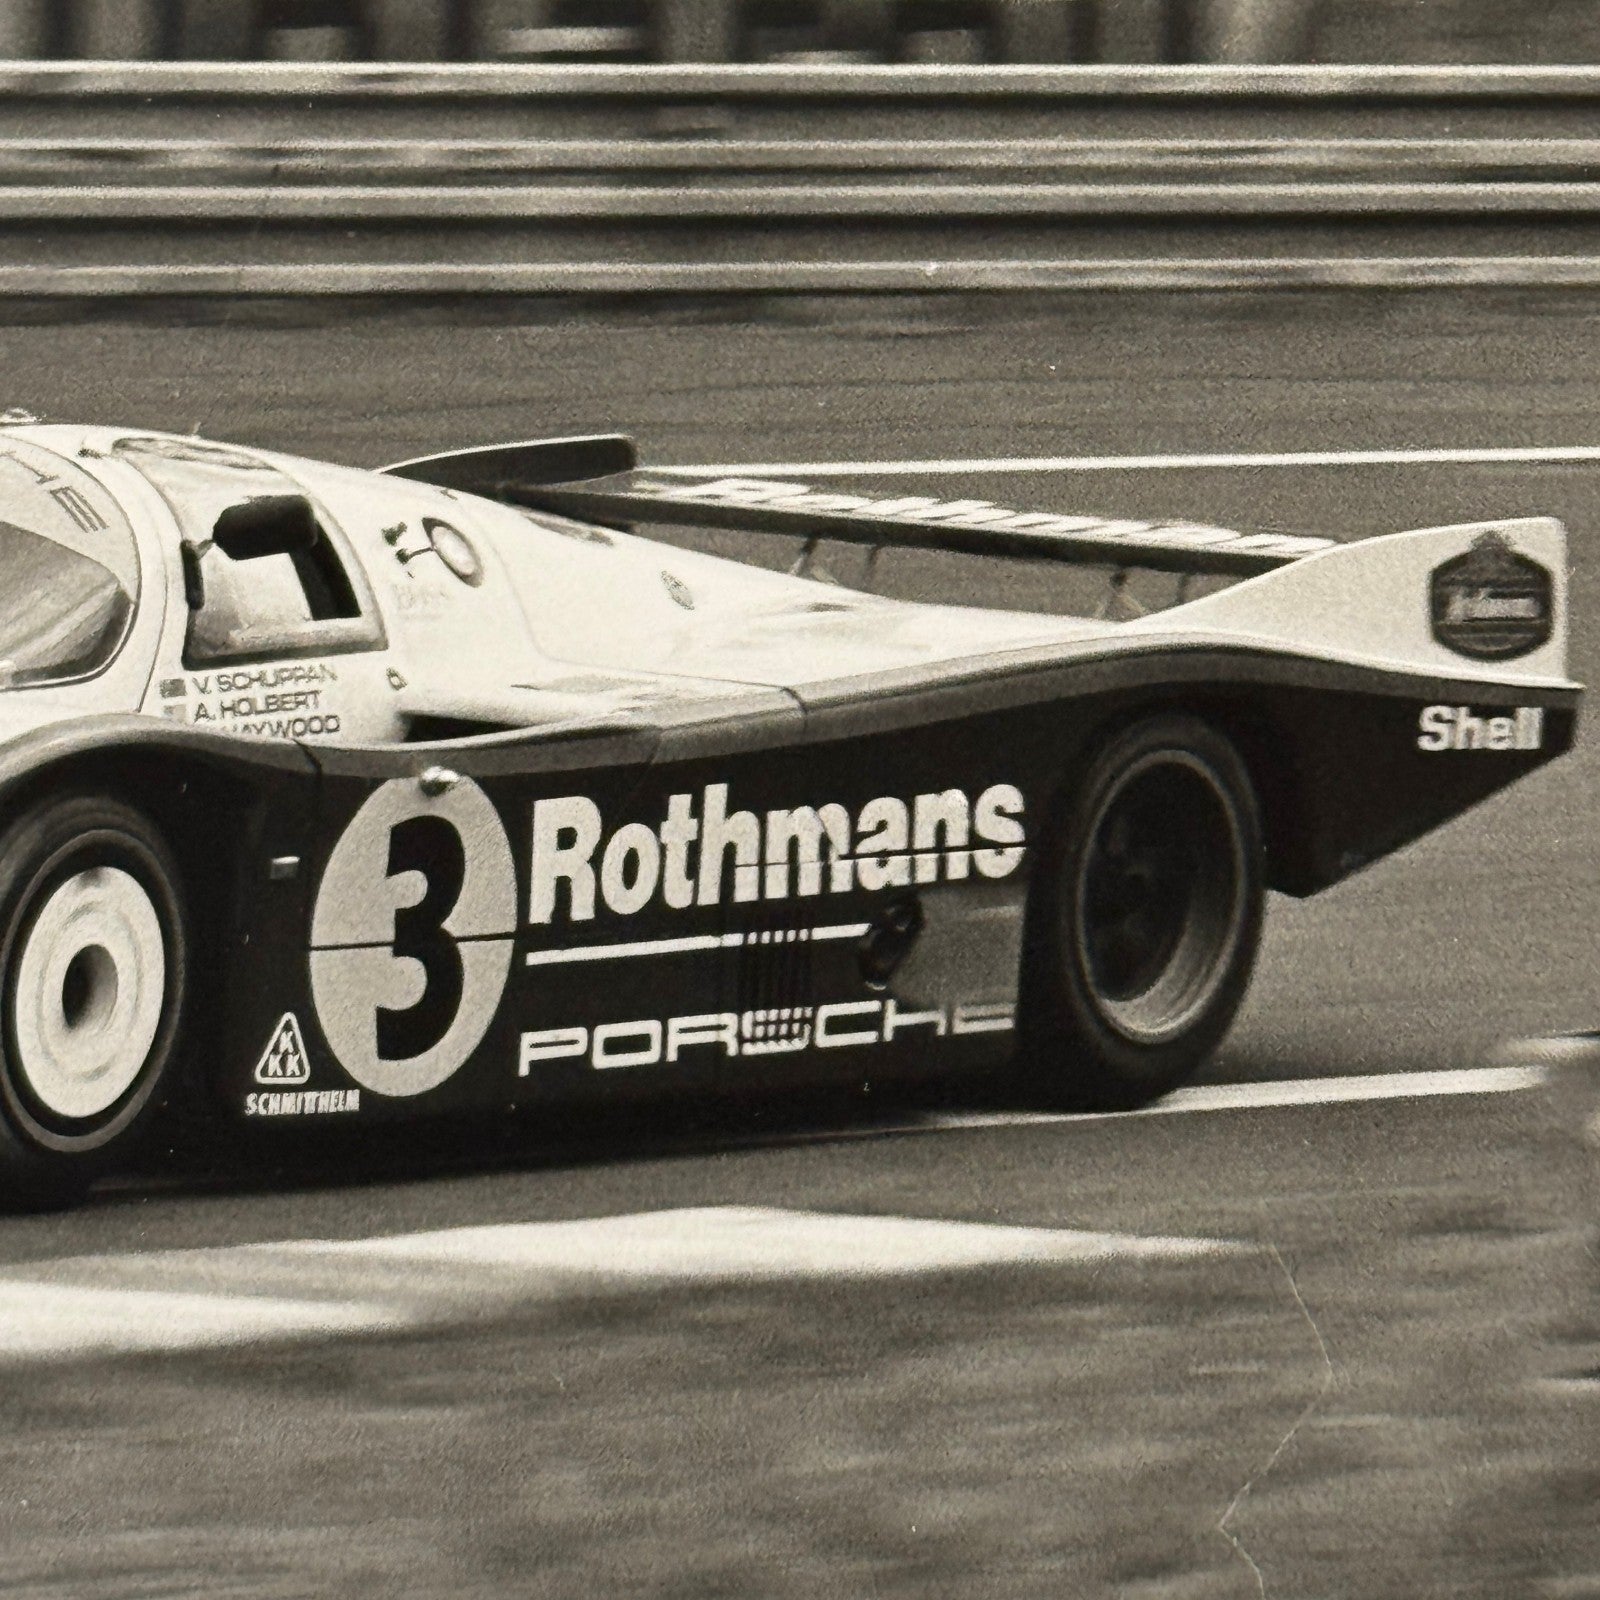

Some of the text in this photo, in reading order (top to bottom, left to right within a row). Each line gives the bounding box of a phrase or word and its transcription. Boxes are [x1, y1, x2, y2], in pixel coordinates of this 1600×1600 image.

[661, 478, 1338, 556] Rothman
[191, 675, 212, 695] V.
[194, 690, 321, 722] A. HOLBERT
[1417, 705, 1543, 751] Shell
[528, 783, 1026, 924] Rothmans
[376, 814, 466, 1062] 3
[517, 999, 1015, 1077] PORSCHE
